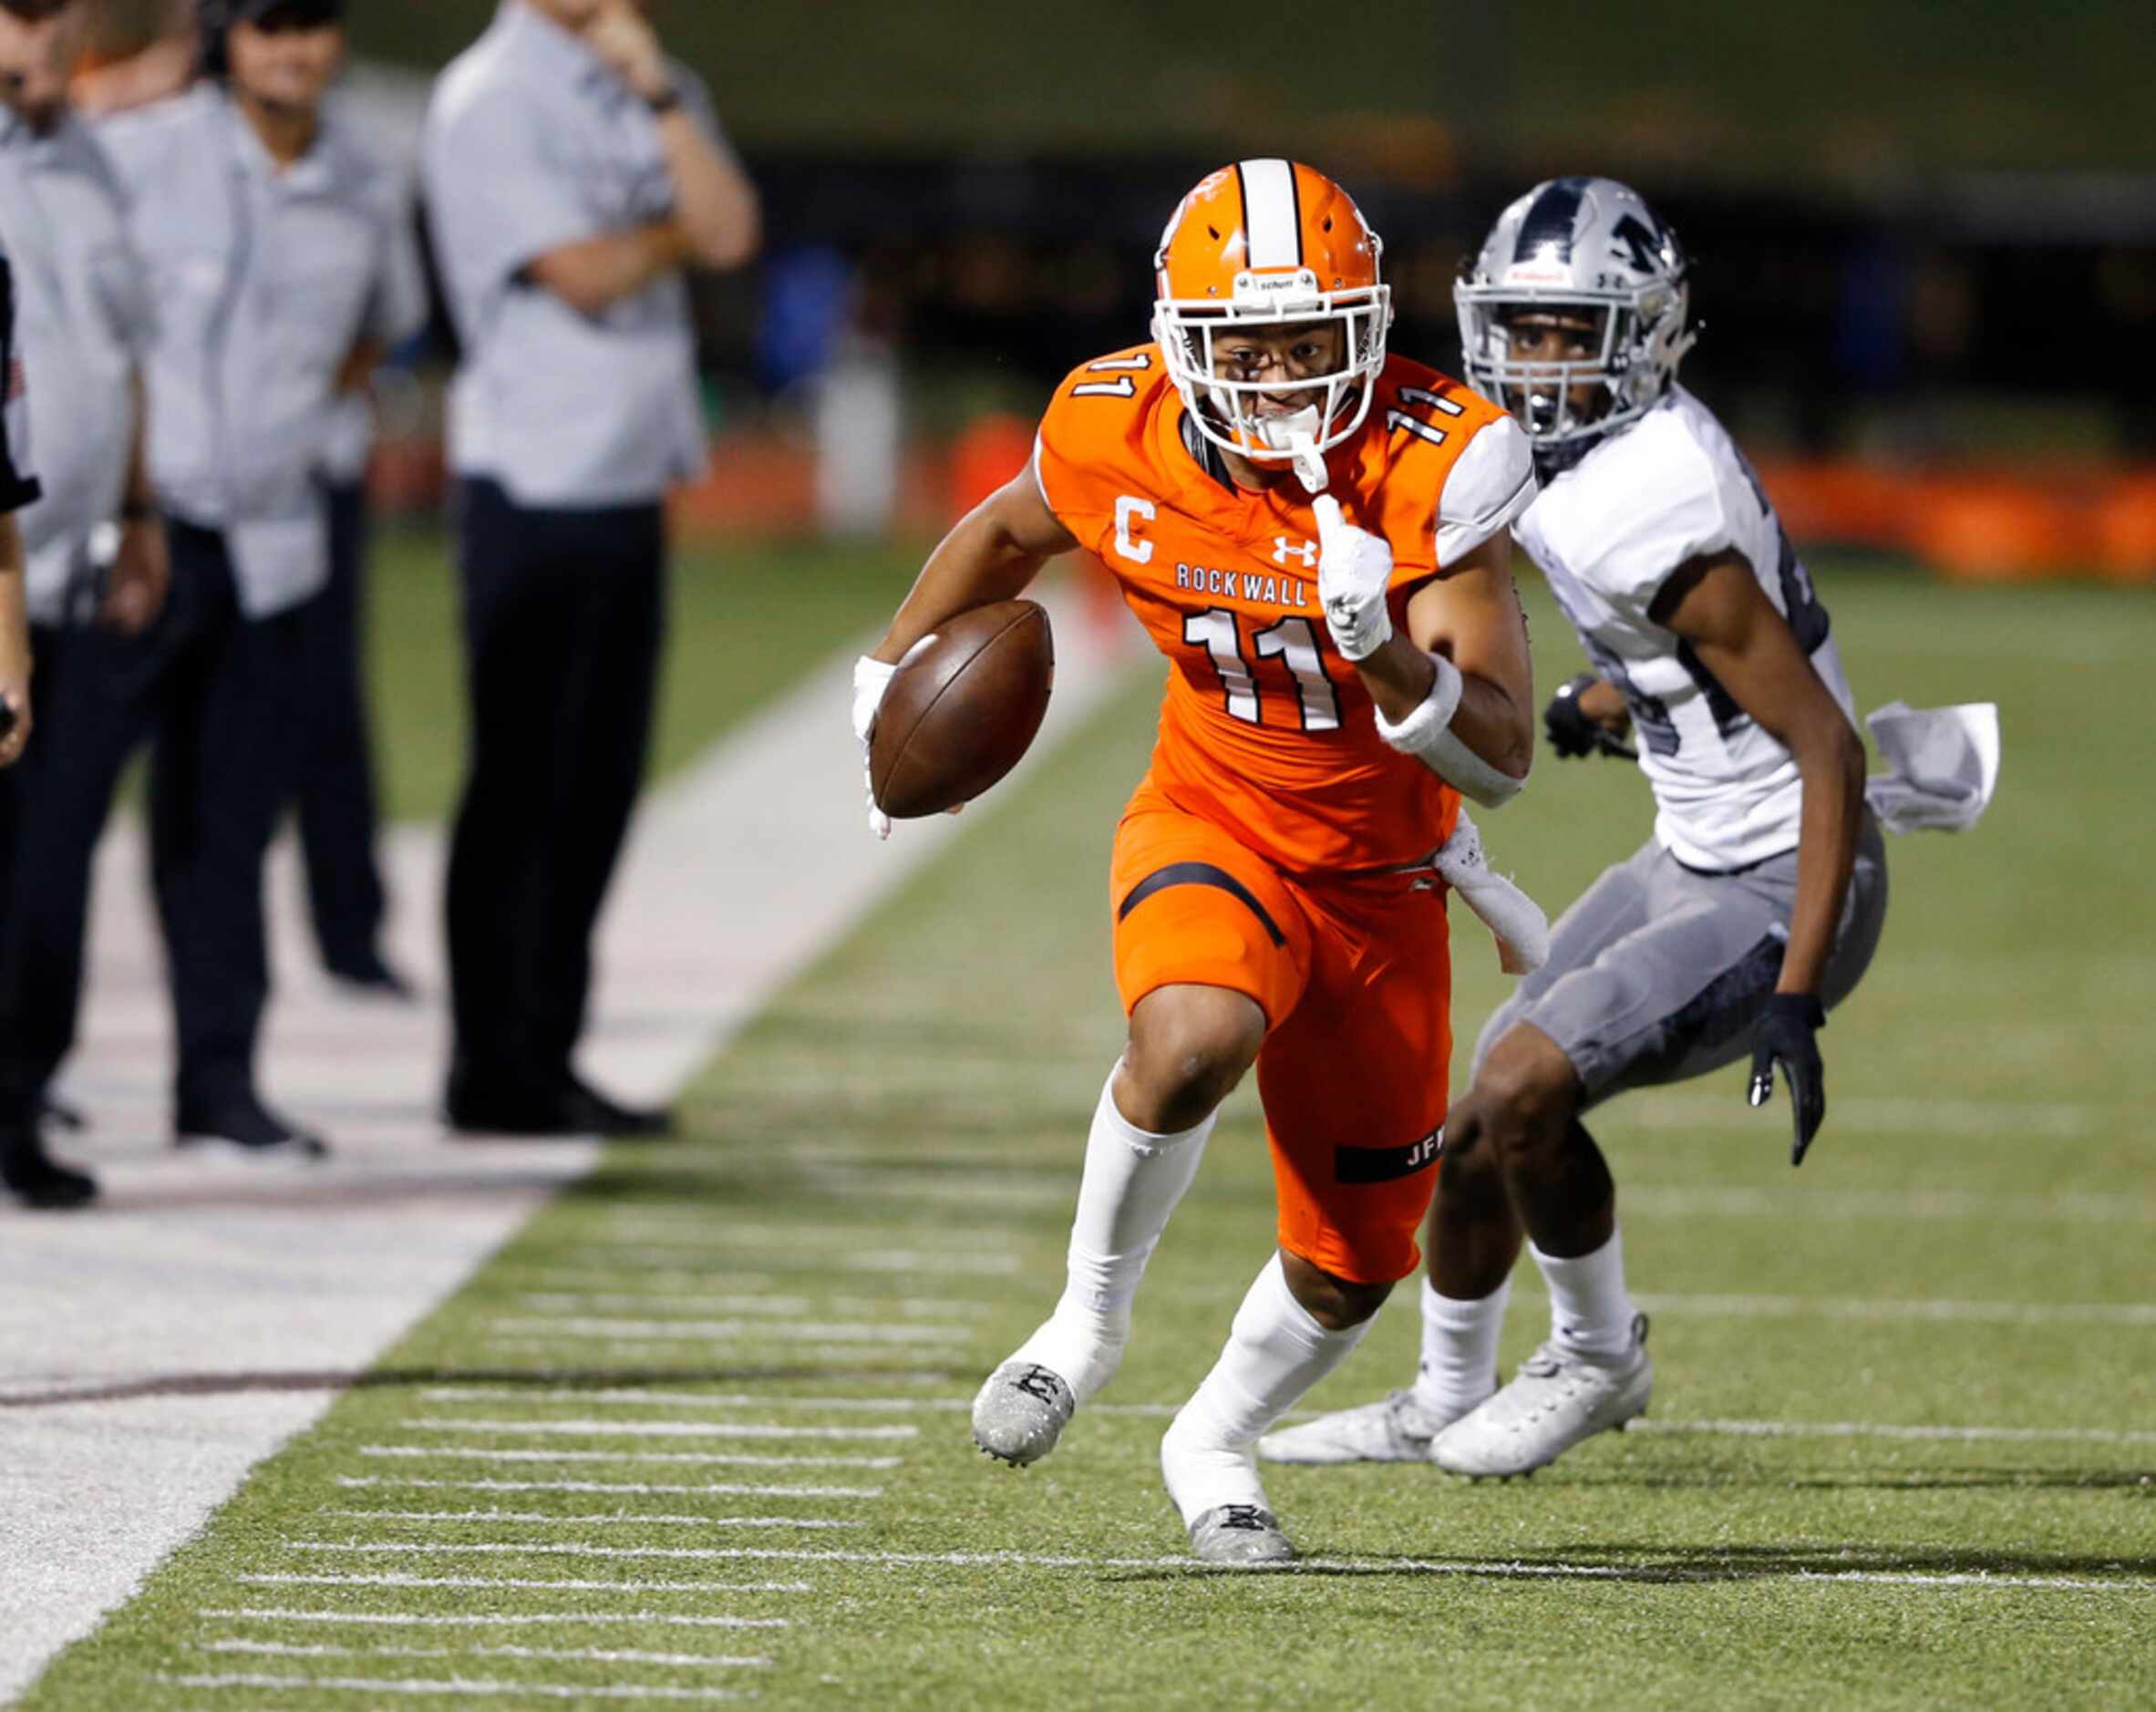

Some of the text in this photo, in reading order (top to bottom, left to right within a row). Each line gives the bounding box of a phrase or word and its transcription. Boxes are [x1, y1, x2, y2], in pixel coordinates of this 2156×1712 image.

[1070, 353, 1152, 398] 11
[1387, 387, 1467, 448] 11
[1115, 495, 1156, 564] C
[1176, 562, 1307, 607] ROCKWALL
[1182, 606, 1342, 731] 11
